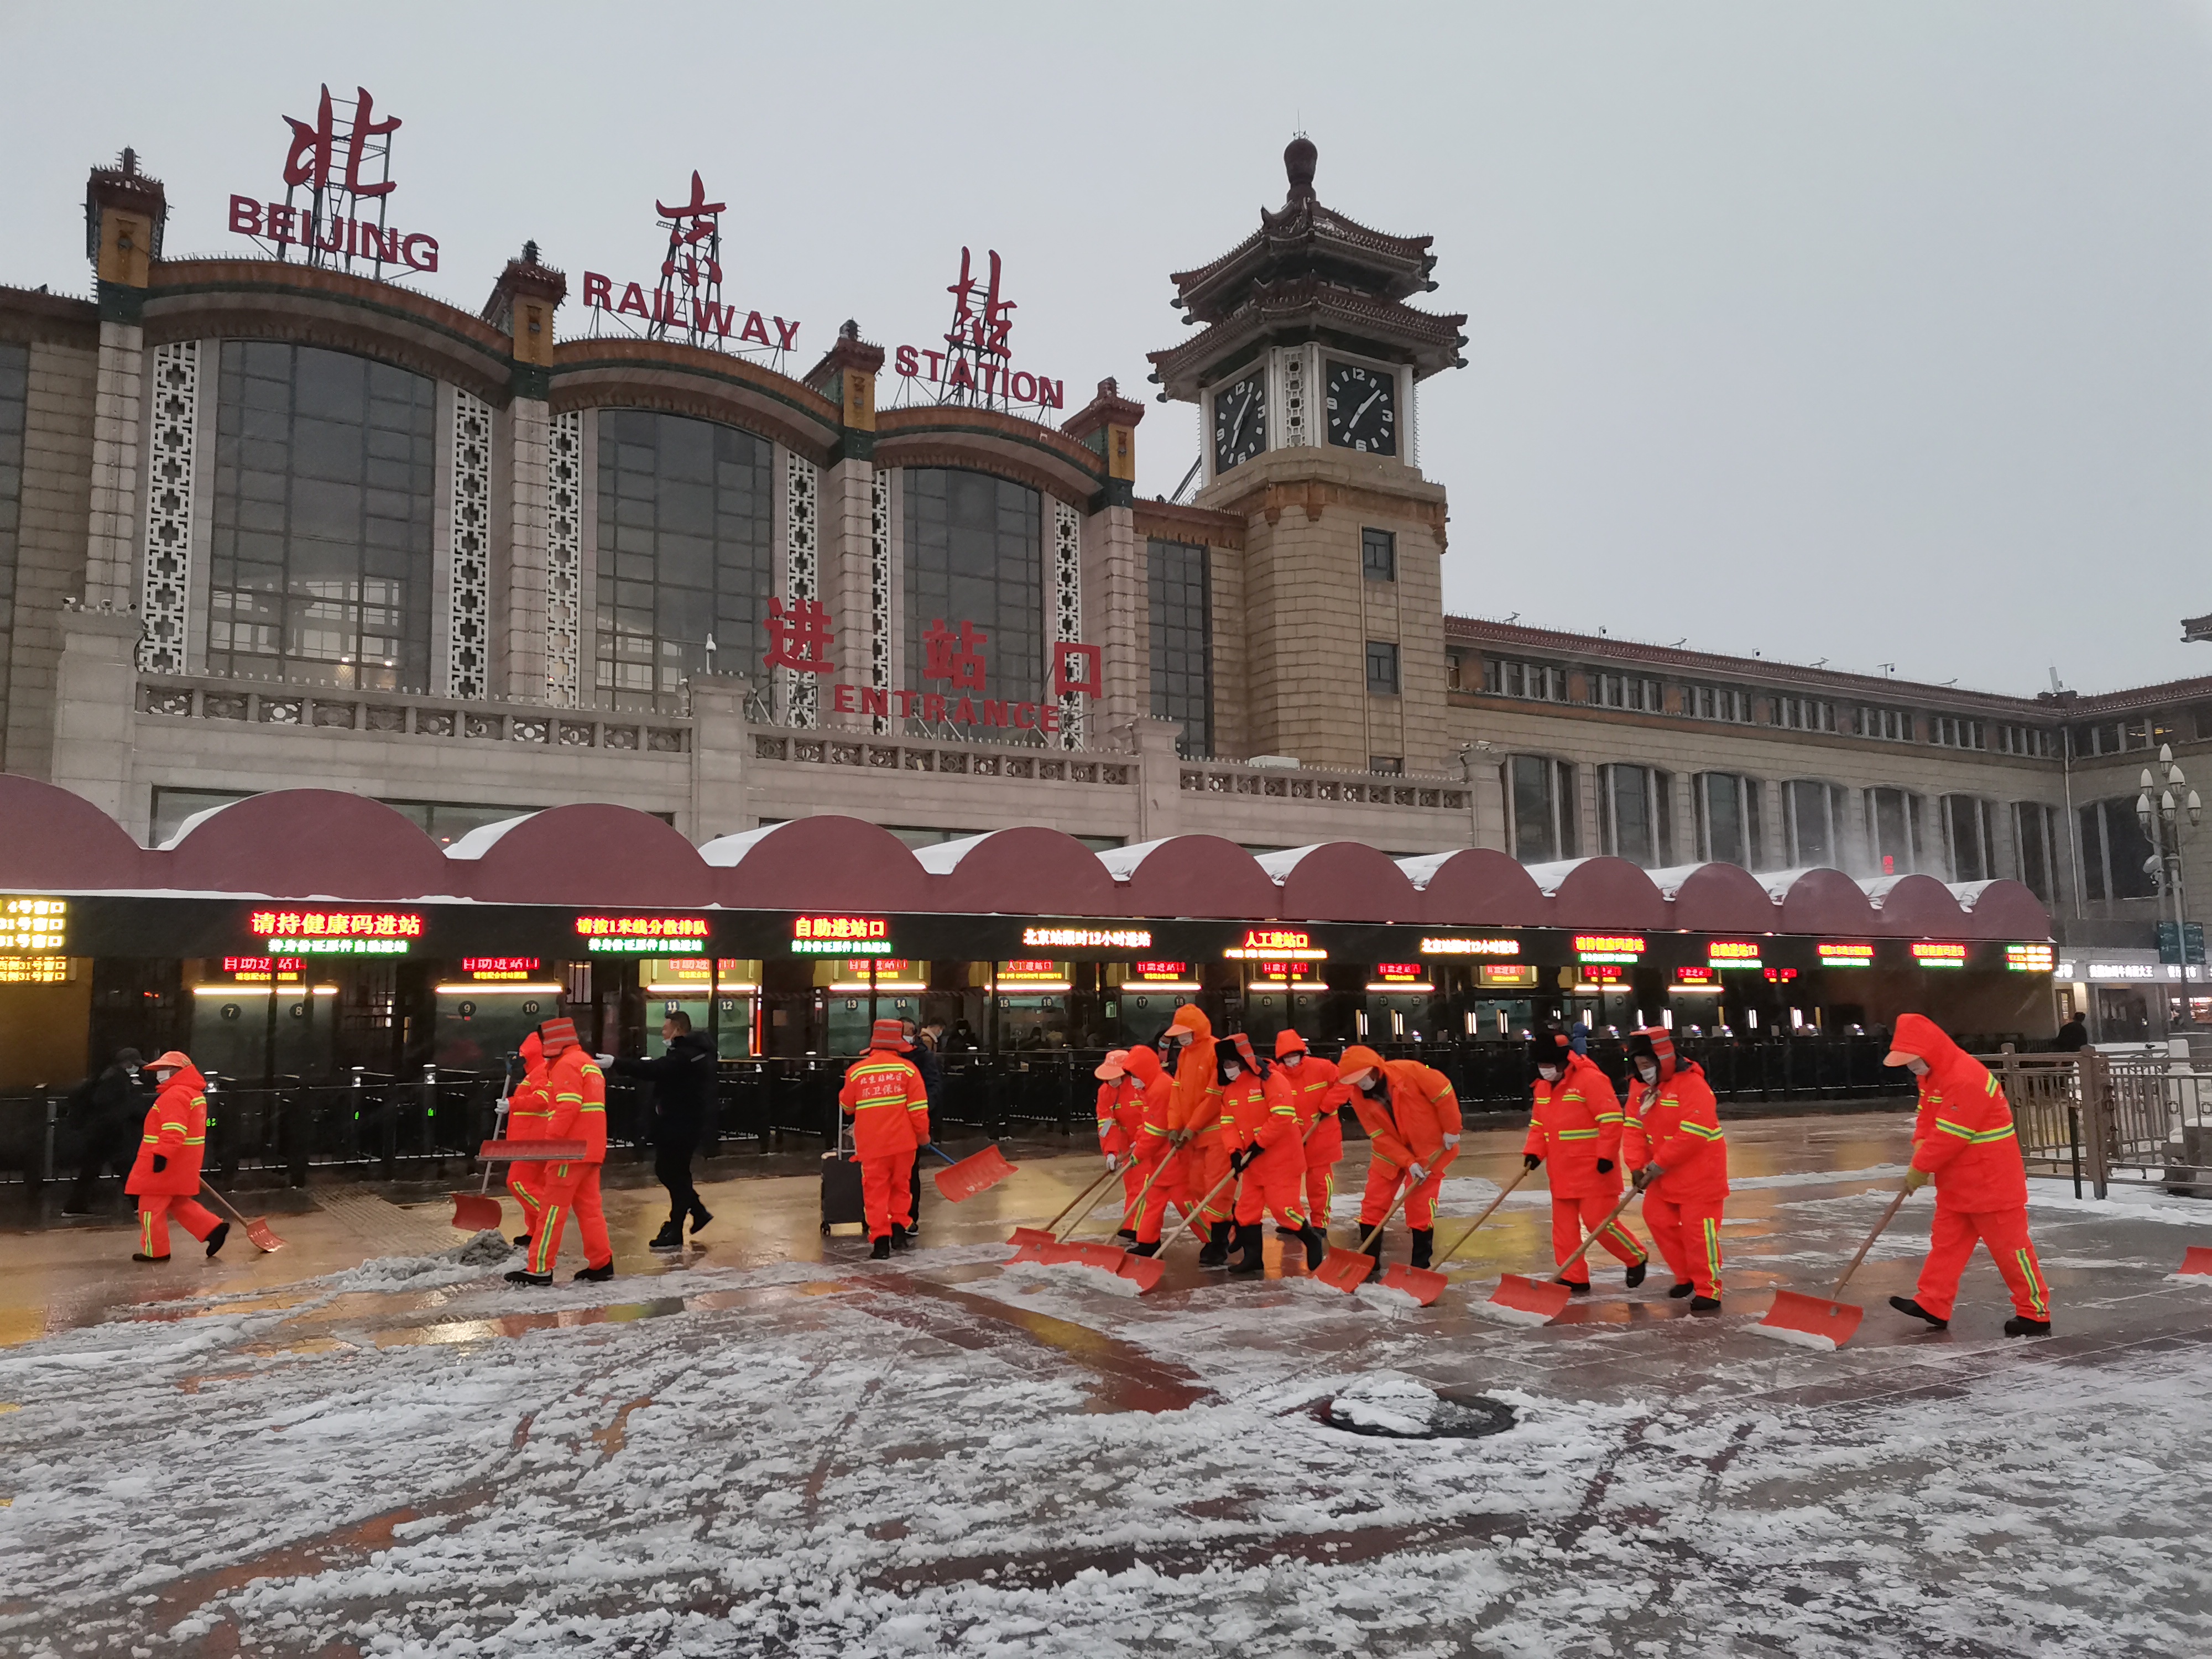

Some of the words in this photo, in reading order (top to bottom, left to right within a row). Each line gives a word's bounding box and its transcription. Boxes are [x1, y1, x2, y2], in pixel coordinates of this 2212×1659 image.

[281, 82, 403, 195] 北
[656, 169, 727, 287] 京
[943, 246, 1018, 359] 站
[228, 194, 439, 273] BEIJING
[583, 270, 801, 351] RAILWAY
[895, 345, 1063, 409] STATION
[1353, 368, 1365, 381] 12
[1235, 382, 1245, 396] 12
[1327, 398, 1338, 410] 9
[1383, 409, 1394, 422] 3
[1217, 428, 1225, 442] 9
[1356, 439, 1367, 452] 6
[763, 597, 1102, 698] 进站口
[834, 684, 1059, 733] ENTRANCE
[251, 912, 422, 936] 请持健康码进站
[576, 917, 709, 936] 请按1米线分散排队
[795, 917, 885, 938] 自助进站口
[1245, 930, 1309, 948] 人工进站口
[463, 1004, 471, 1013] 9
[525, 1004, 537, 1013] 10
[667, 1001, 678, 1011] 11
[722, 1001, 733, 1010] 12
[847, 1000, 857, 1009] 13
[897, 999, 906, 1008] 14
[1000, 999, 1009, 1008] 15
[1043, 998, 1052, 1007] 16
[1138, 998, 1147, 1007] 17
[227, 1008, 234, 1016] 7
[295, 1006, 302, 1016] 8
